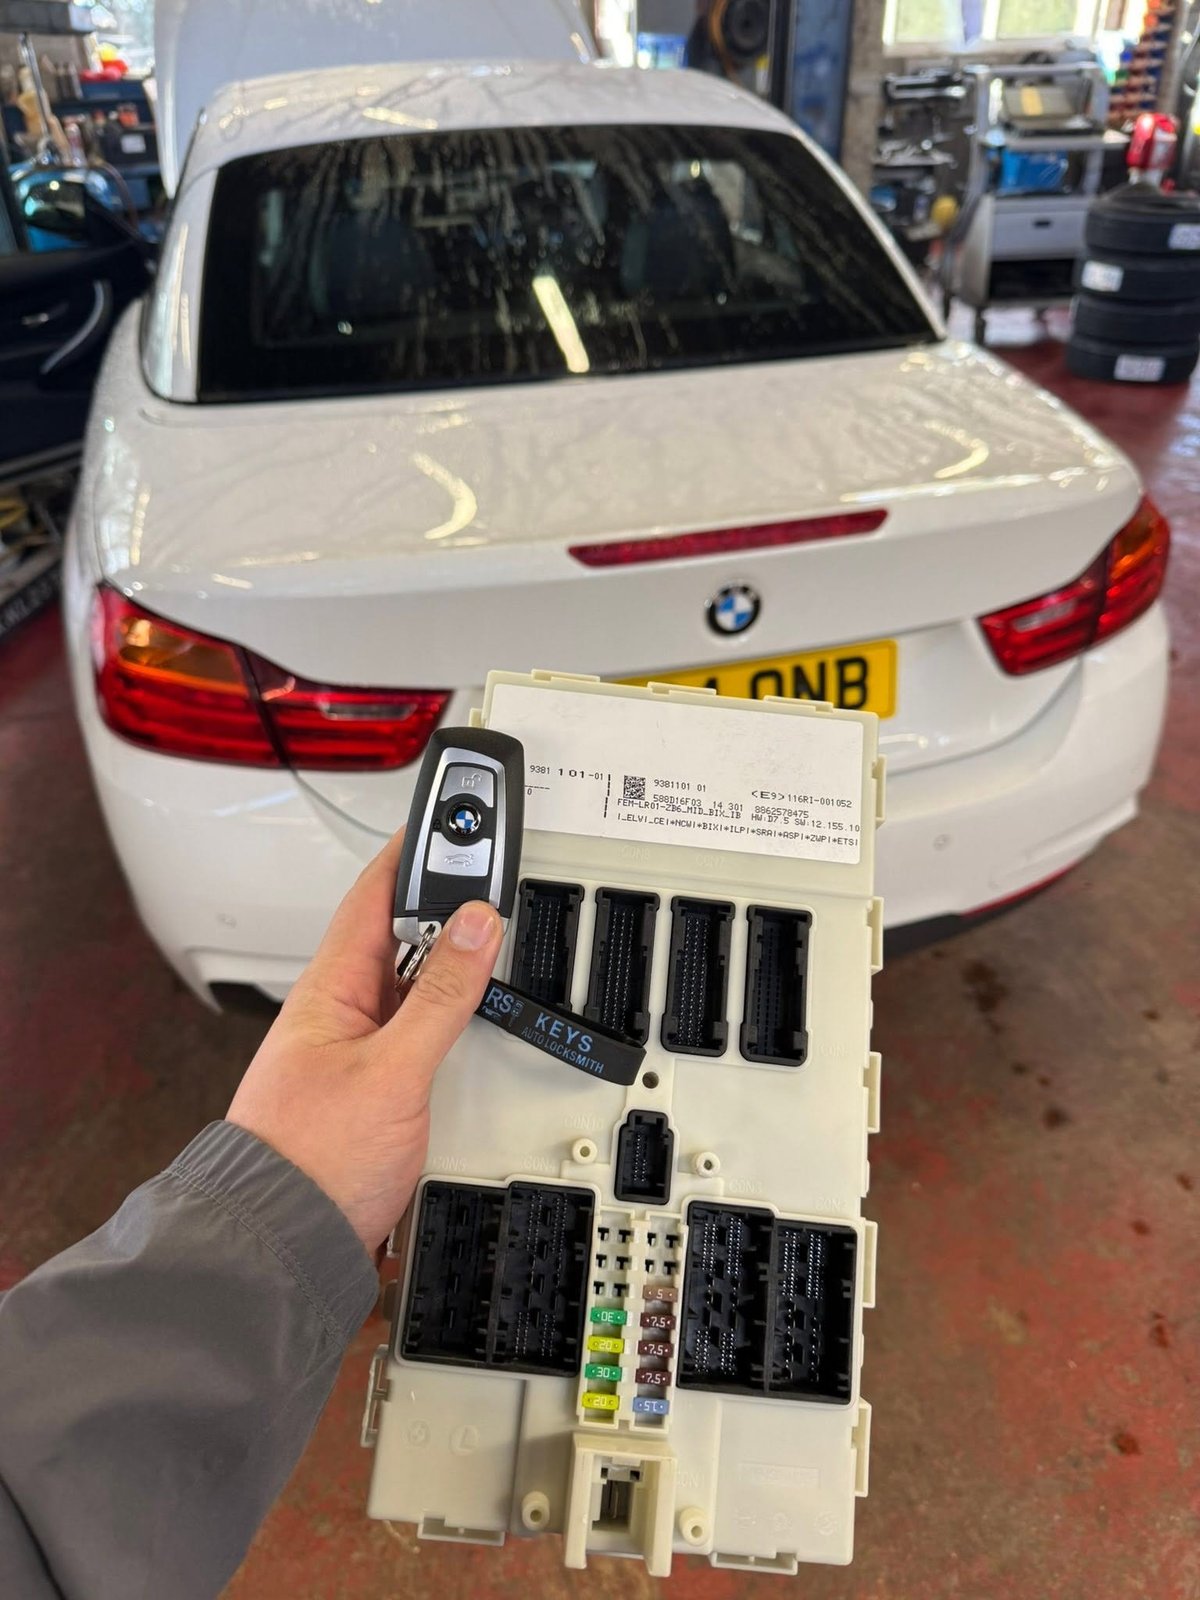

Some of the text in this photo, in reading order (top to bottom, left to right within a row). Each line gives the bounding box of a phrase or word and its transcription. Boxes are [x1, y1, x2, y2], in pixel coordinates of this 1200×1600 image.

[529, 764, 550, 774] 9381
[653, 778, 690, 791] 9381101
[696, 783, 706, 792] 01
[653, 793, 702, 807] 588D16F03
[754, 805, 809, 819] 8862578475
[485, 986, 593, 1053] RS KEYS
[521, 1026, 605, 1074] AUTO LOCKSMITH
[651, 1316, 666, 1328] 7.5
[648, 1343, 664, 1356] 7.5
[596, 1366, 610, 1378] 30
[645, 1372, 661, 1385] 7.5
[593, 1396, 607, 1408] 20
